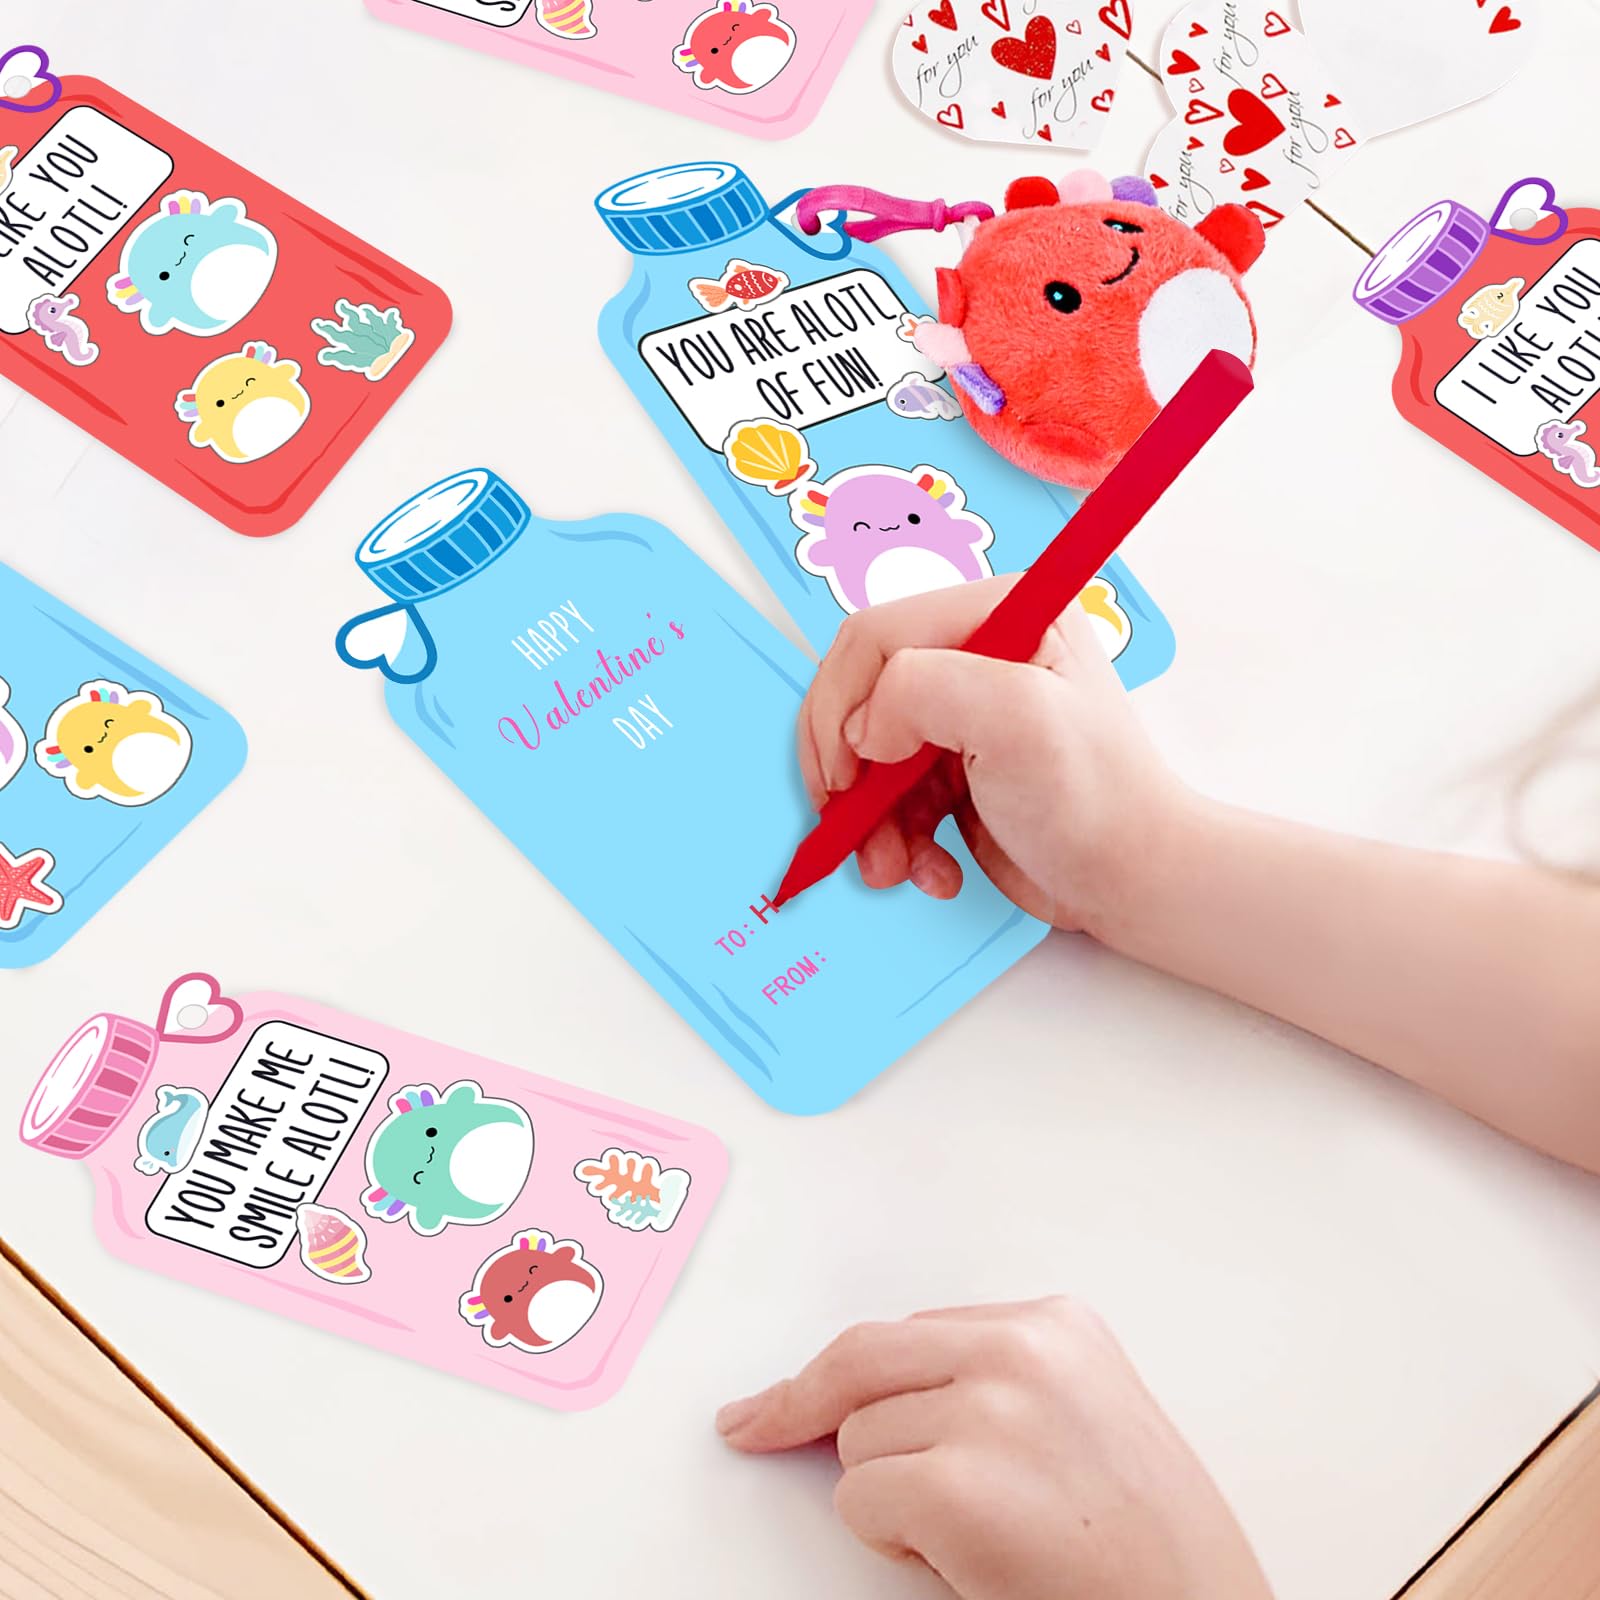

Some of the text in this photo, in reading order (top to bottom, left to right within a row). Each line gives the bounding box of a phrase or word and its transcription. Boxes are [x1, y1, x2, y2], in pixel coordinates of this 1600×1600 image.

[939, 35, 979, 98] you
[1224, 2, 1259, 67] you
[1022, 59, 1094, 139] for you
[28, 134, 98, 192] YOU
[1282, 91, 1329, 189] for you
[1179, 150, 1216, 215] you
[22, 184, 128, 287] ALOTL!
[656, 282, 897, 386] YOU ARE ALOTL
[1460, 267, 1600, 405] I LIKE YOU
[756, 347, 884, 420] OF FUN!
[511, 599, 595, 671] HAPPY
[497, 611, 685, 751] Valentine's
[612, 694, 673, 750] DAY
[714, 893, 780, 956] TO: H
[761, 950, 827, 1006] FROM:
[164, 1041, 314, 1230] YOU MAKE ME
[229, 1057, 376, 1250] SMILE ALOTL!
